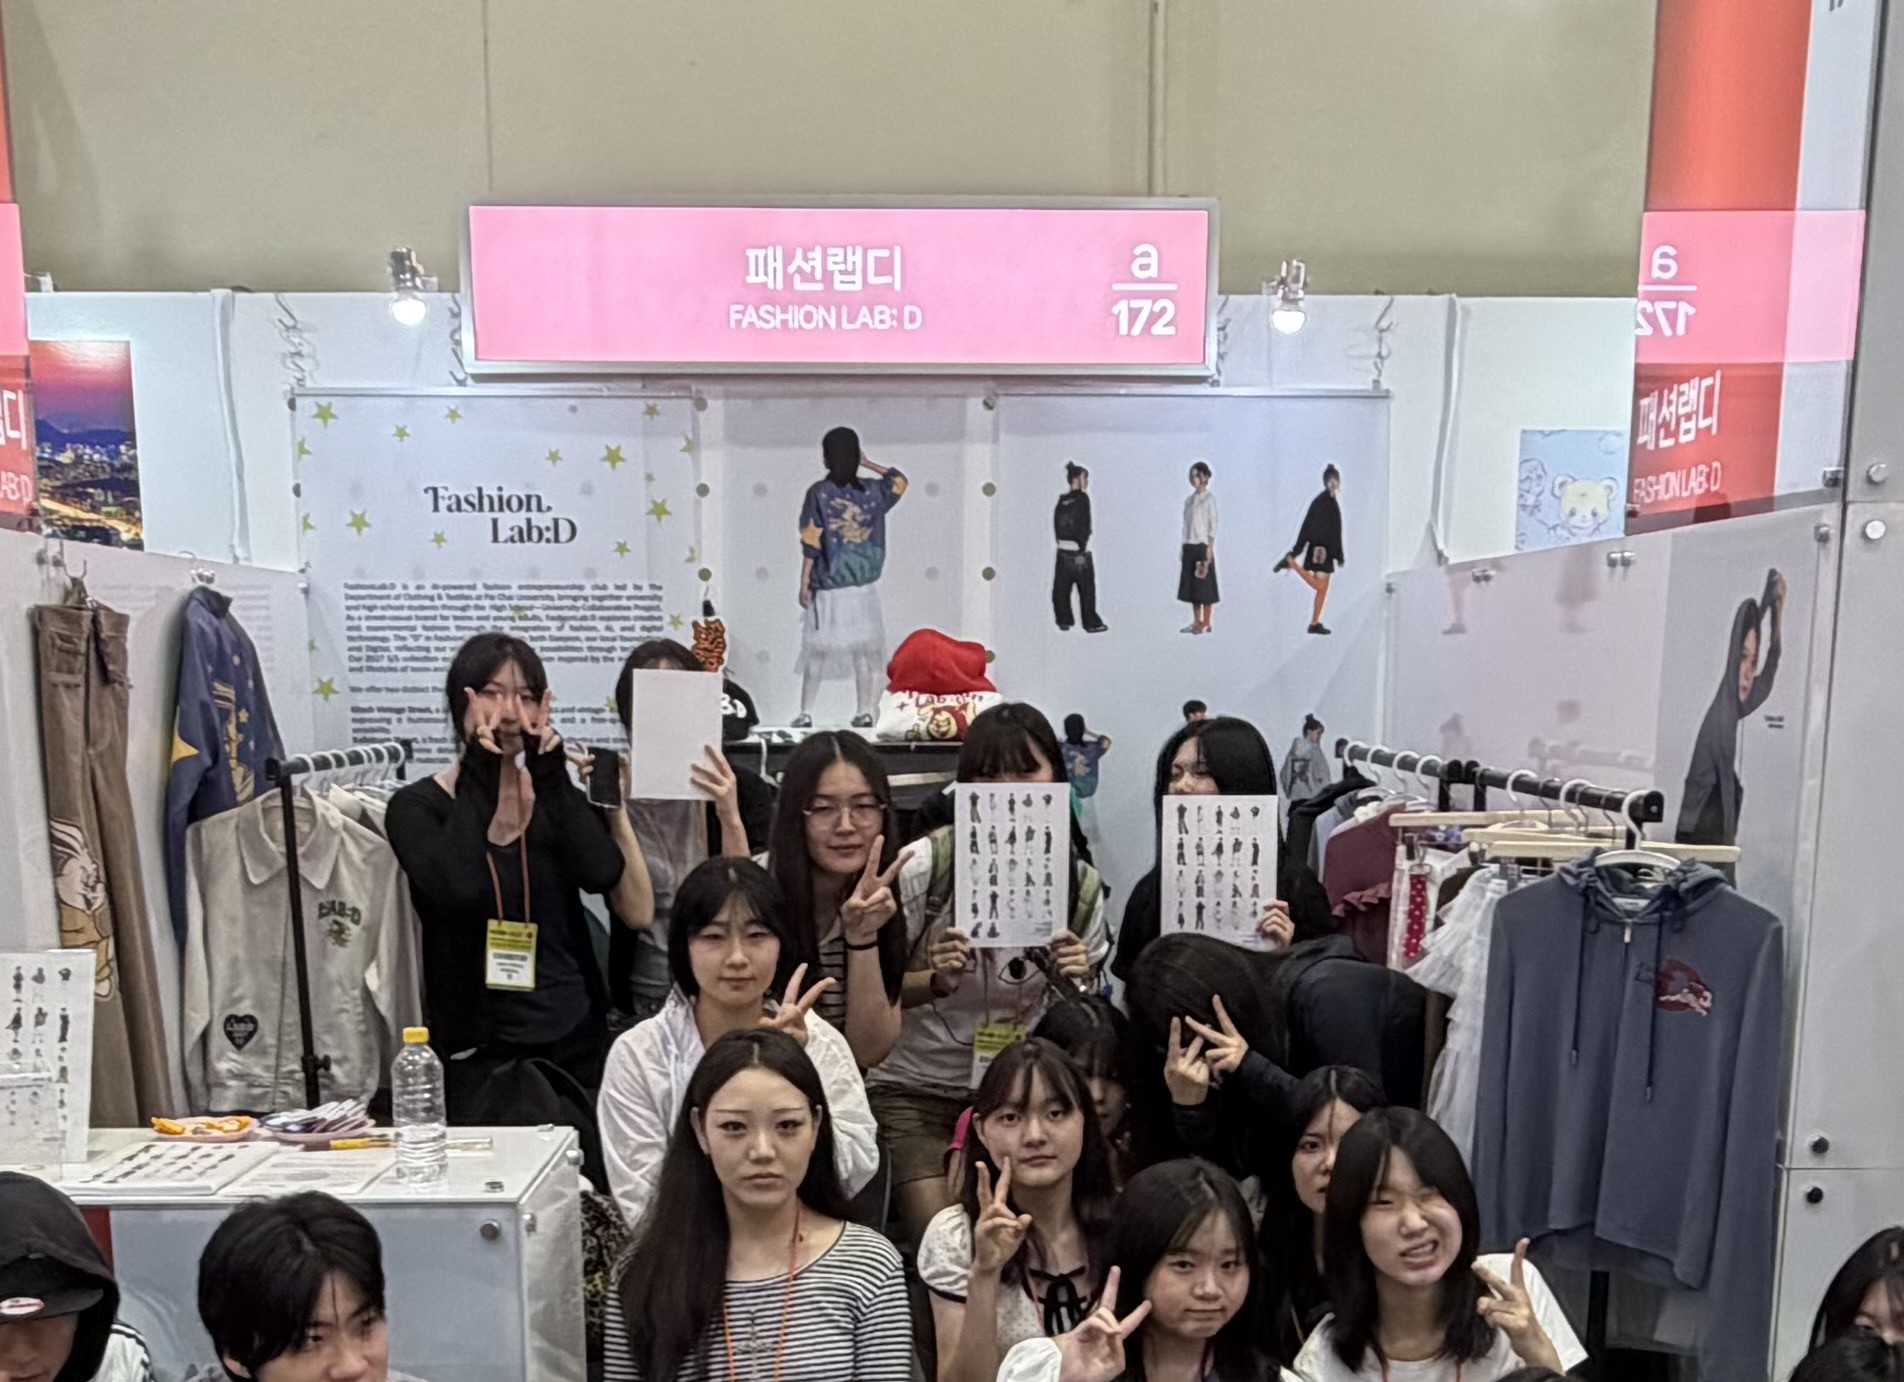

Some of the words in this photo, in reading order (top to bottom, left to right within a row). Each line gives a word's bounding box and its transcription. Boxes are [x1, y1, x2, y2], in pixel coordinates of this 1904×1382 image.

[744, 244, 902, 292] 패션랩디
[1129, 242, 1160, 280] a
[728, 303, 838, 331] FASHION
[840, 303, 899, 331] LAB:
[903, 305, 924, 330] D
[1111, 297, 1177, 337] 172
[1637, 368, 1722, 451] 패션랩디
[1633, 470, 1682, 504] FASHION
[1710, 460, 1722, 492] D
[490, 517, 578, 546] Lab:D
